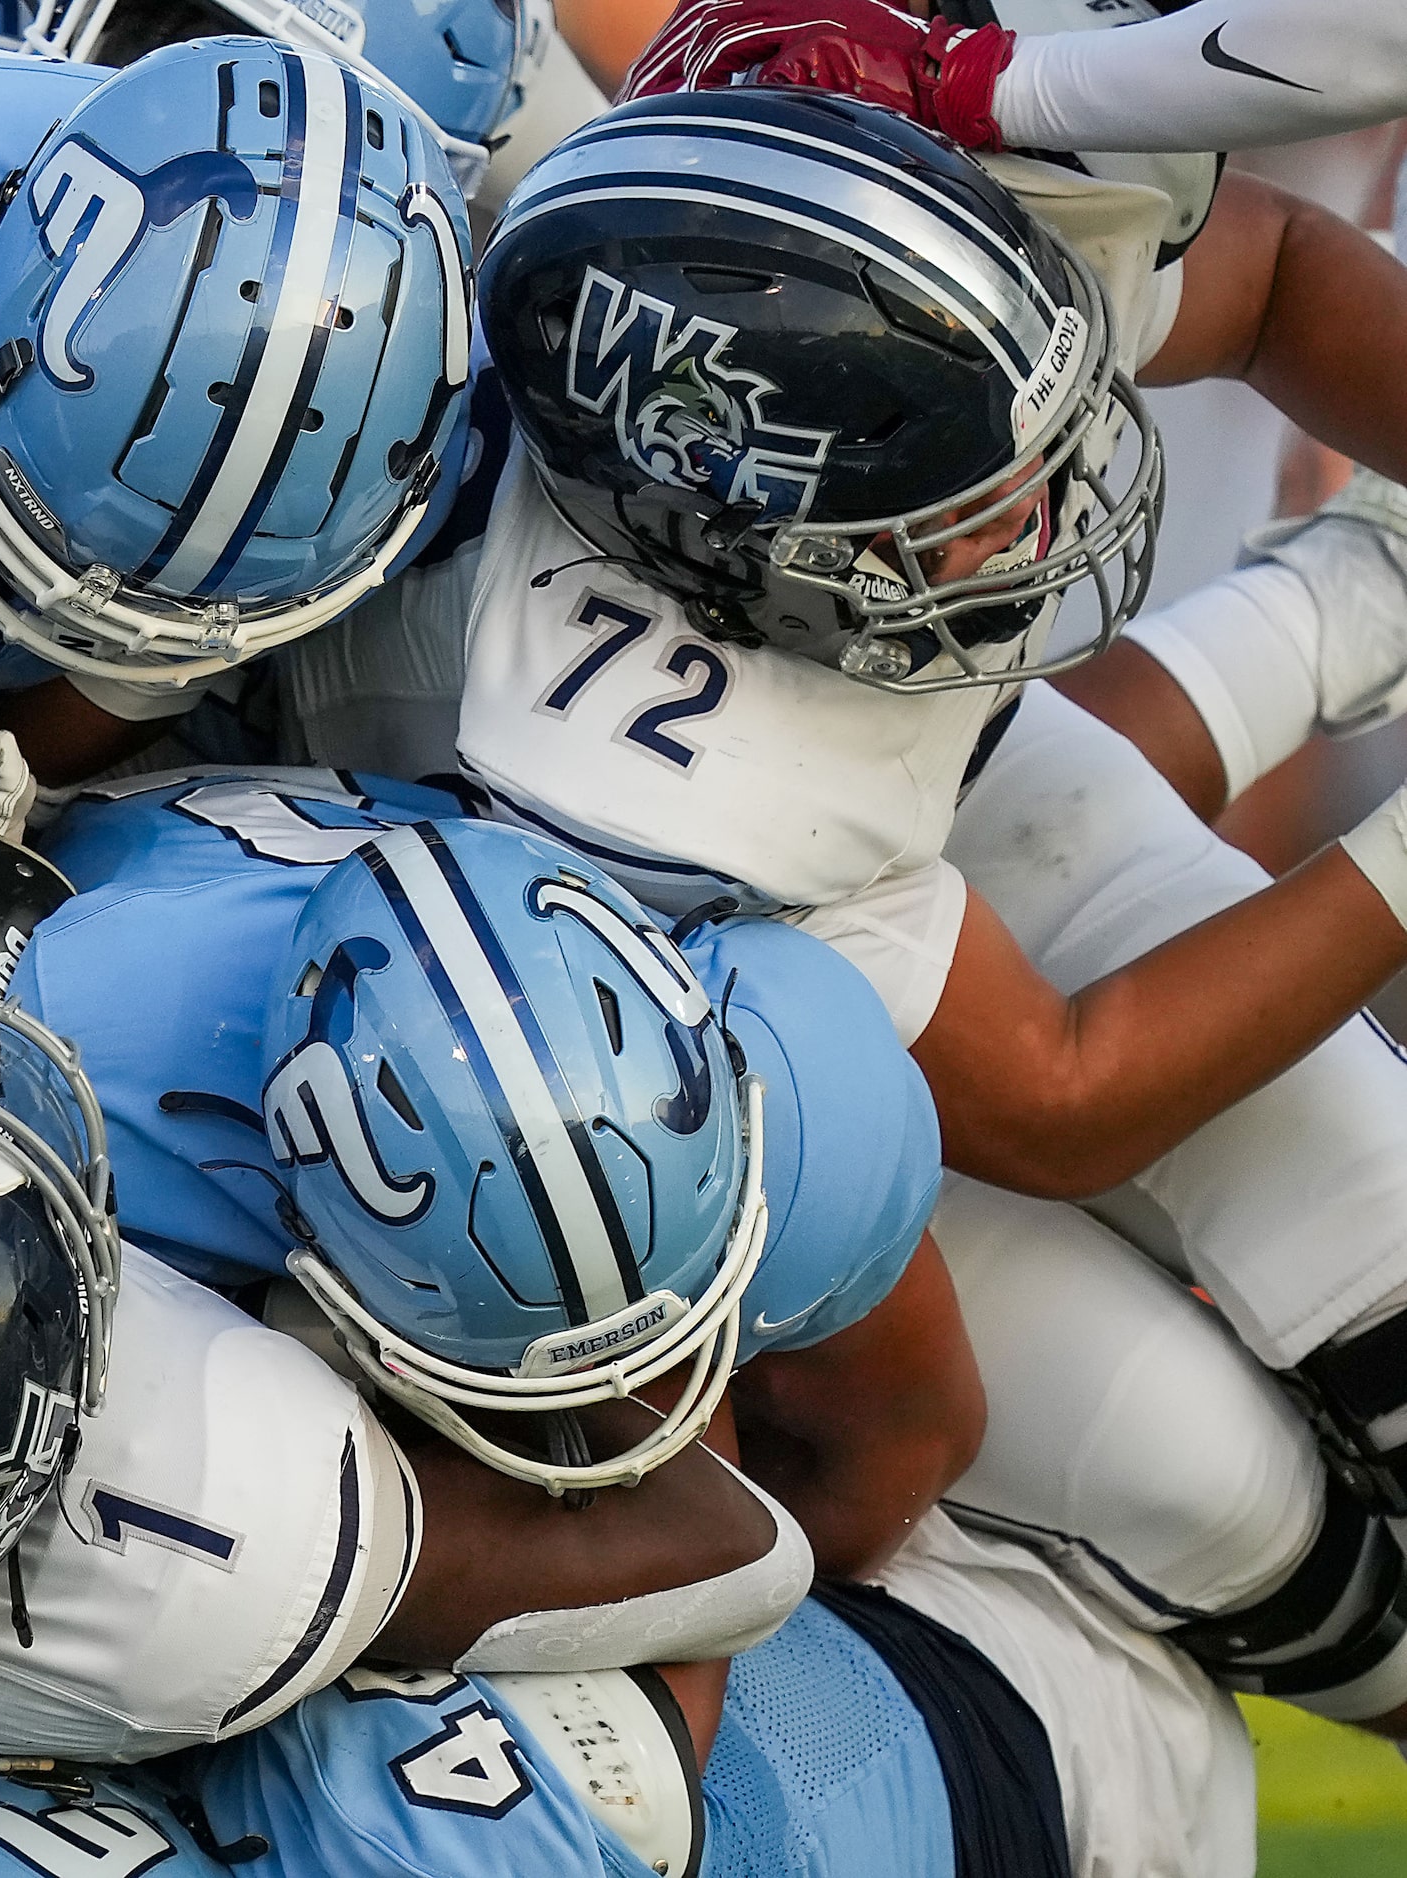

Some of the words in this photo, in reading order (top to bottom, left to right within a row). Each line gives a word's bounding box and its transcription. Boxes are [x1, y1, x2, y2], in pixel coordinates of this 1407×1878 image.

[1027, 372, 1056, 412] THE
[1050, 312, 1079, 374] GROVE
[5, 467, 54, 530] NXTRND
[848, 572, 910, 603] Riddell
[531, 586, 736, 780] 72
[548, 1302, 666, 1364] EMERSON
[81, 1478, 247, 1574] 1
